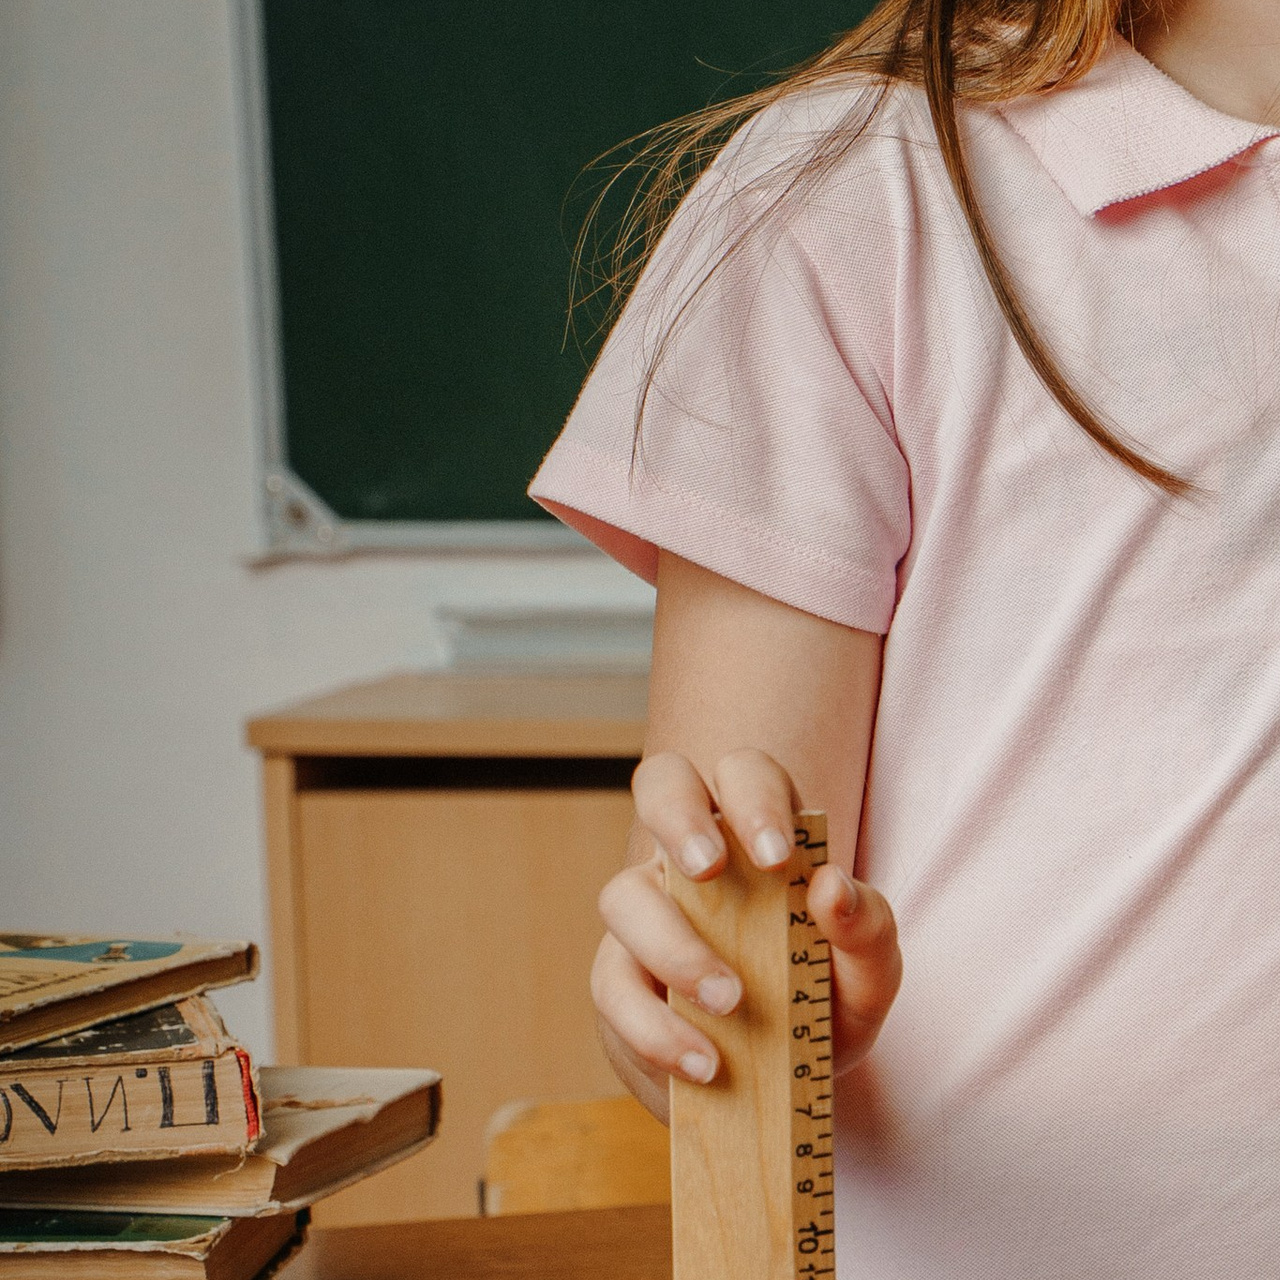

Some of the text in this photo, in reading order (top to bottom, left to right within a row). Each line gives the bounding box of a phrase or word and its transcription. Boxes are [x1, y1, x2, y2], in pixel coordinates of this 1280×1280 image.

[790, 875, 808, 886] 1
[790, 911, 807, 926] 2
[791, 951, 809, 965] 3
[792, 990, 810, 1004] 4
[793, 1025, 810, 1040] 5
[794, 1064, 811, 1080] 6
[795, 1103, 812, 1117] 7
[796, 1144, 813, 1158] 8
[797, 1179, 814, 1194] 9
[798, 1221, 819, 1255] 10
